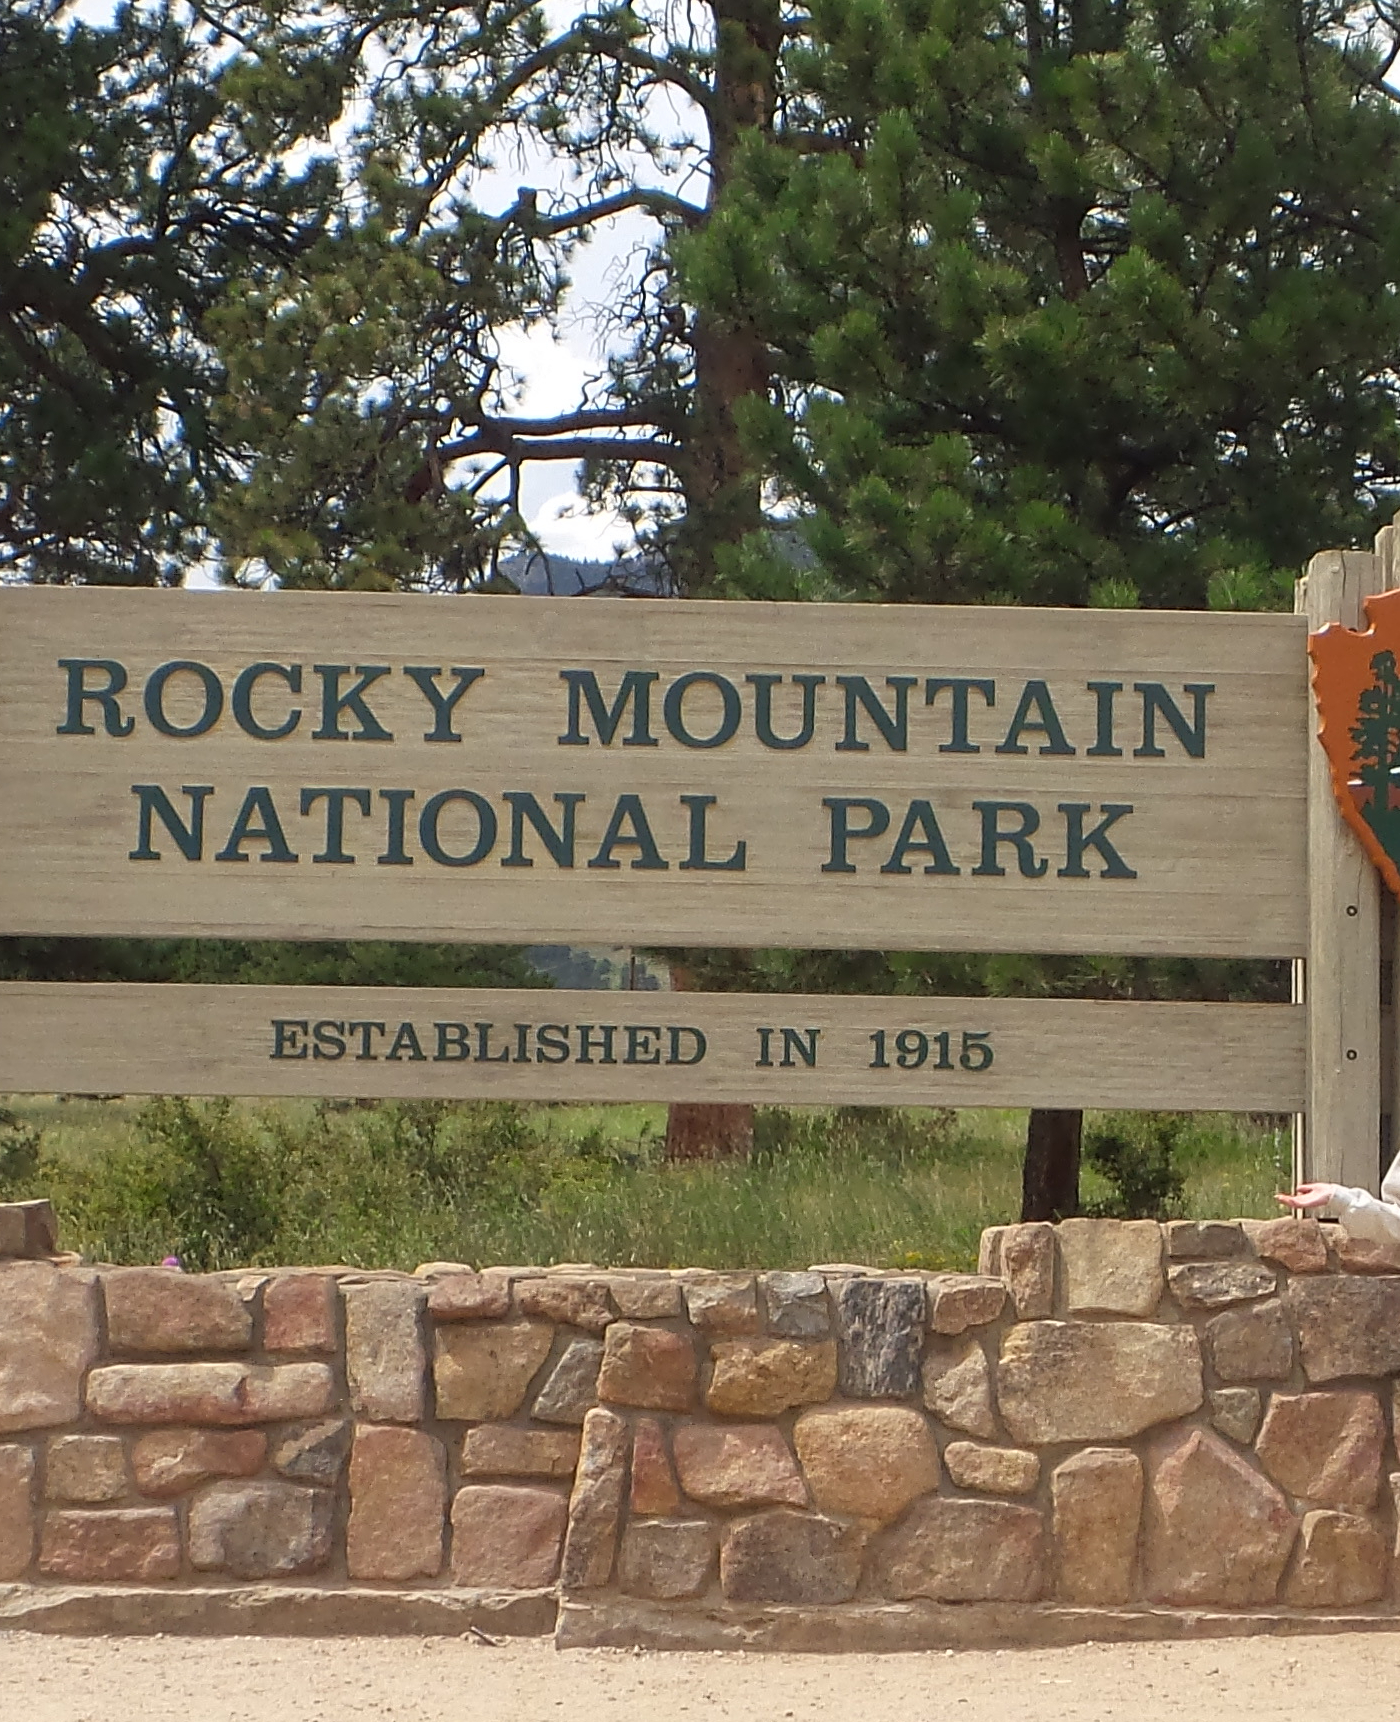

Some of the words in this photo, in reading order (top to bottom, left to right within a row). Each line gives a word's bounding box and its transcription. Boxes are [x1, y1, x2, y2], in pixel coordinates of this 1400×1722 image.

[56, 658, 485, 742] ROCKY
[558, 669, 1216, 758] MOUNTAIN
[129, 784, 747, 871] NATIONAL
[822, 798, 1138, 879] PARK
[270, 1019, 706, 1066] ESTABLISHED
[756, 1028, 820, 1068] IN
[869, 1029, 993, 1072] 1915
